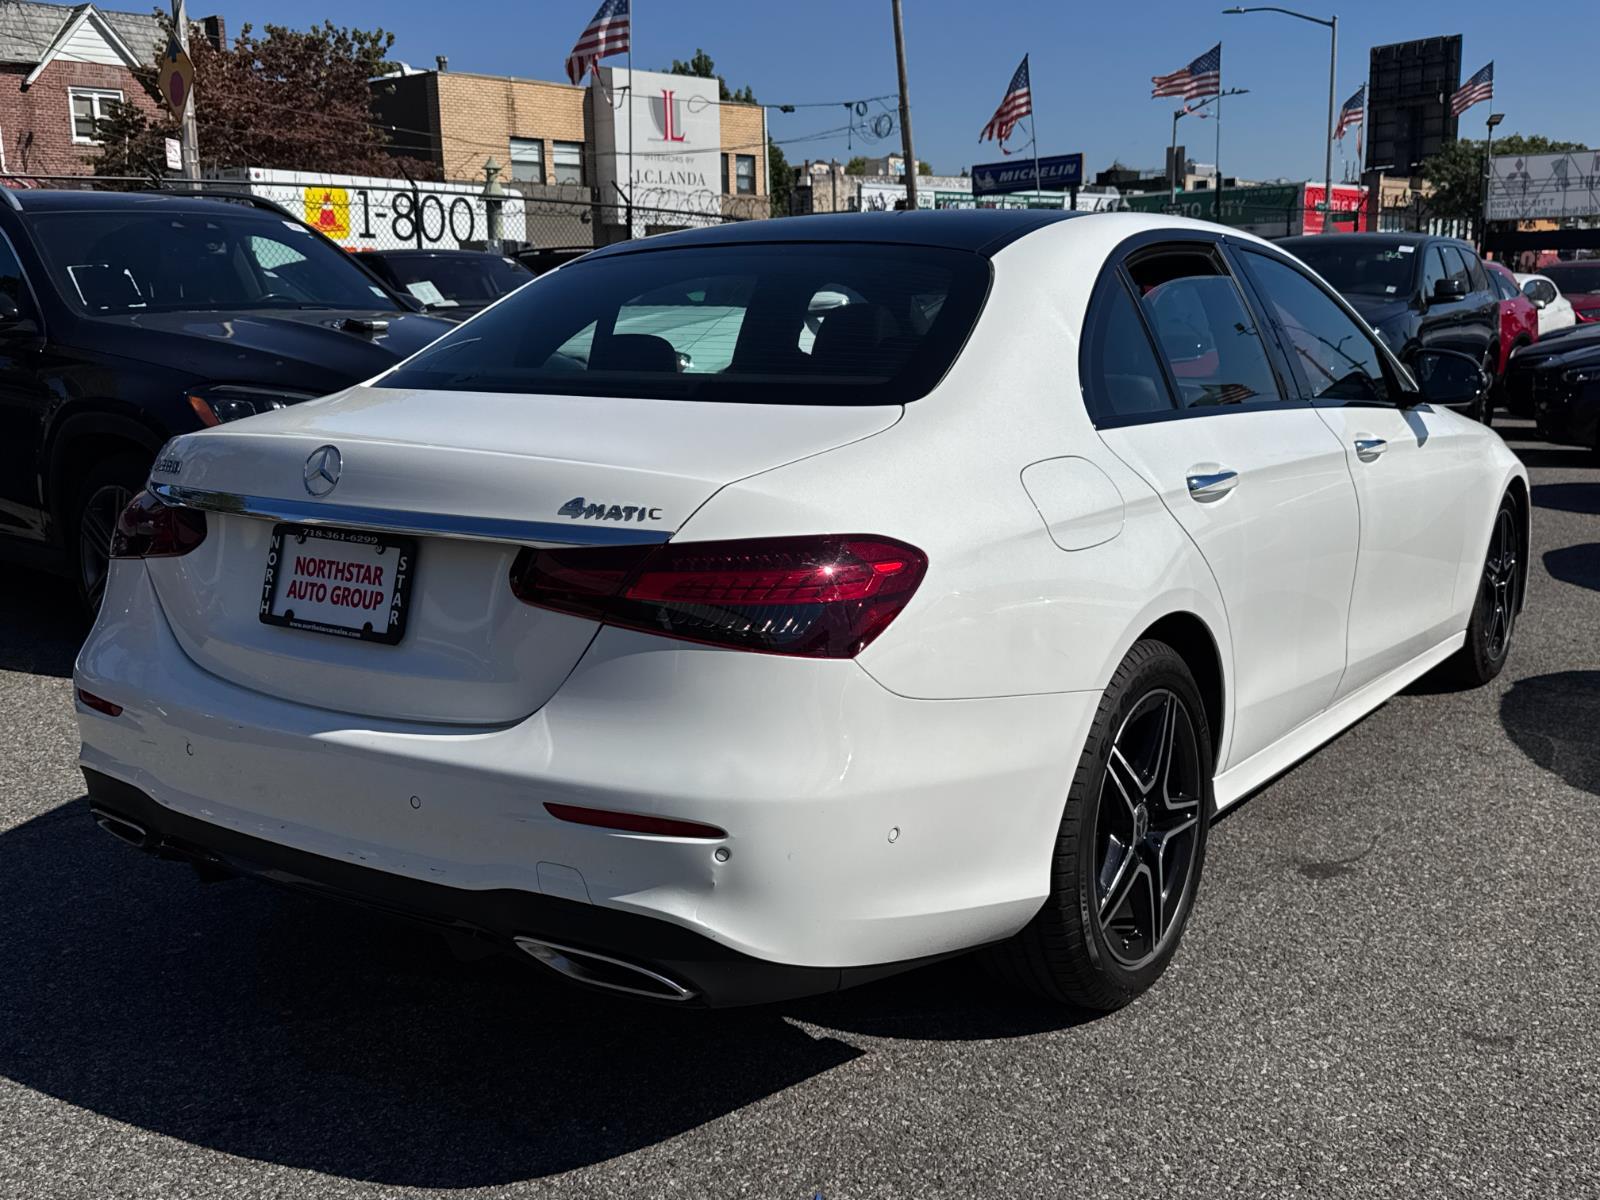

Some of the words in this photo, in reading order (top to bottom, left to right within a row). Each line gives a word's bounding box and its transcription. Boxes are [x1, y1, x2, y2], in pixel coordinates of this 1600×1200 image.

[999, 163, 1077, 182] MICHELIN
[355, 189, 475, 243] 1-800
[557, 497, 663, 522] 4MATIC
[303, 528, 379, 545] 718-361-6299
[260, 535, 281, 615] NORTH
[294, 556, 384, 586] NORTHSTAR
[286, 579, 327, 603] AUTO
[330, 585, 384, 611] GROUP
[389, 556, 408, 625] STAR
